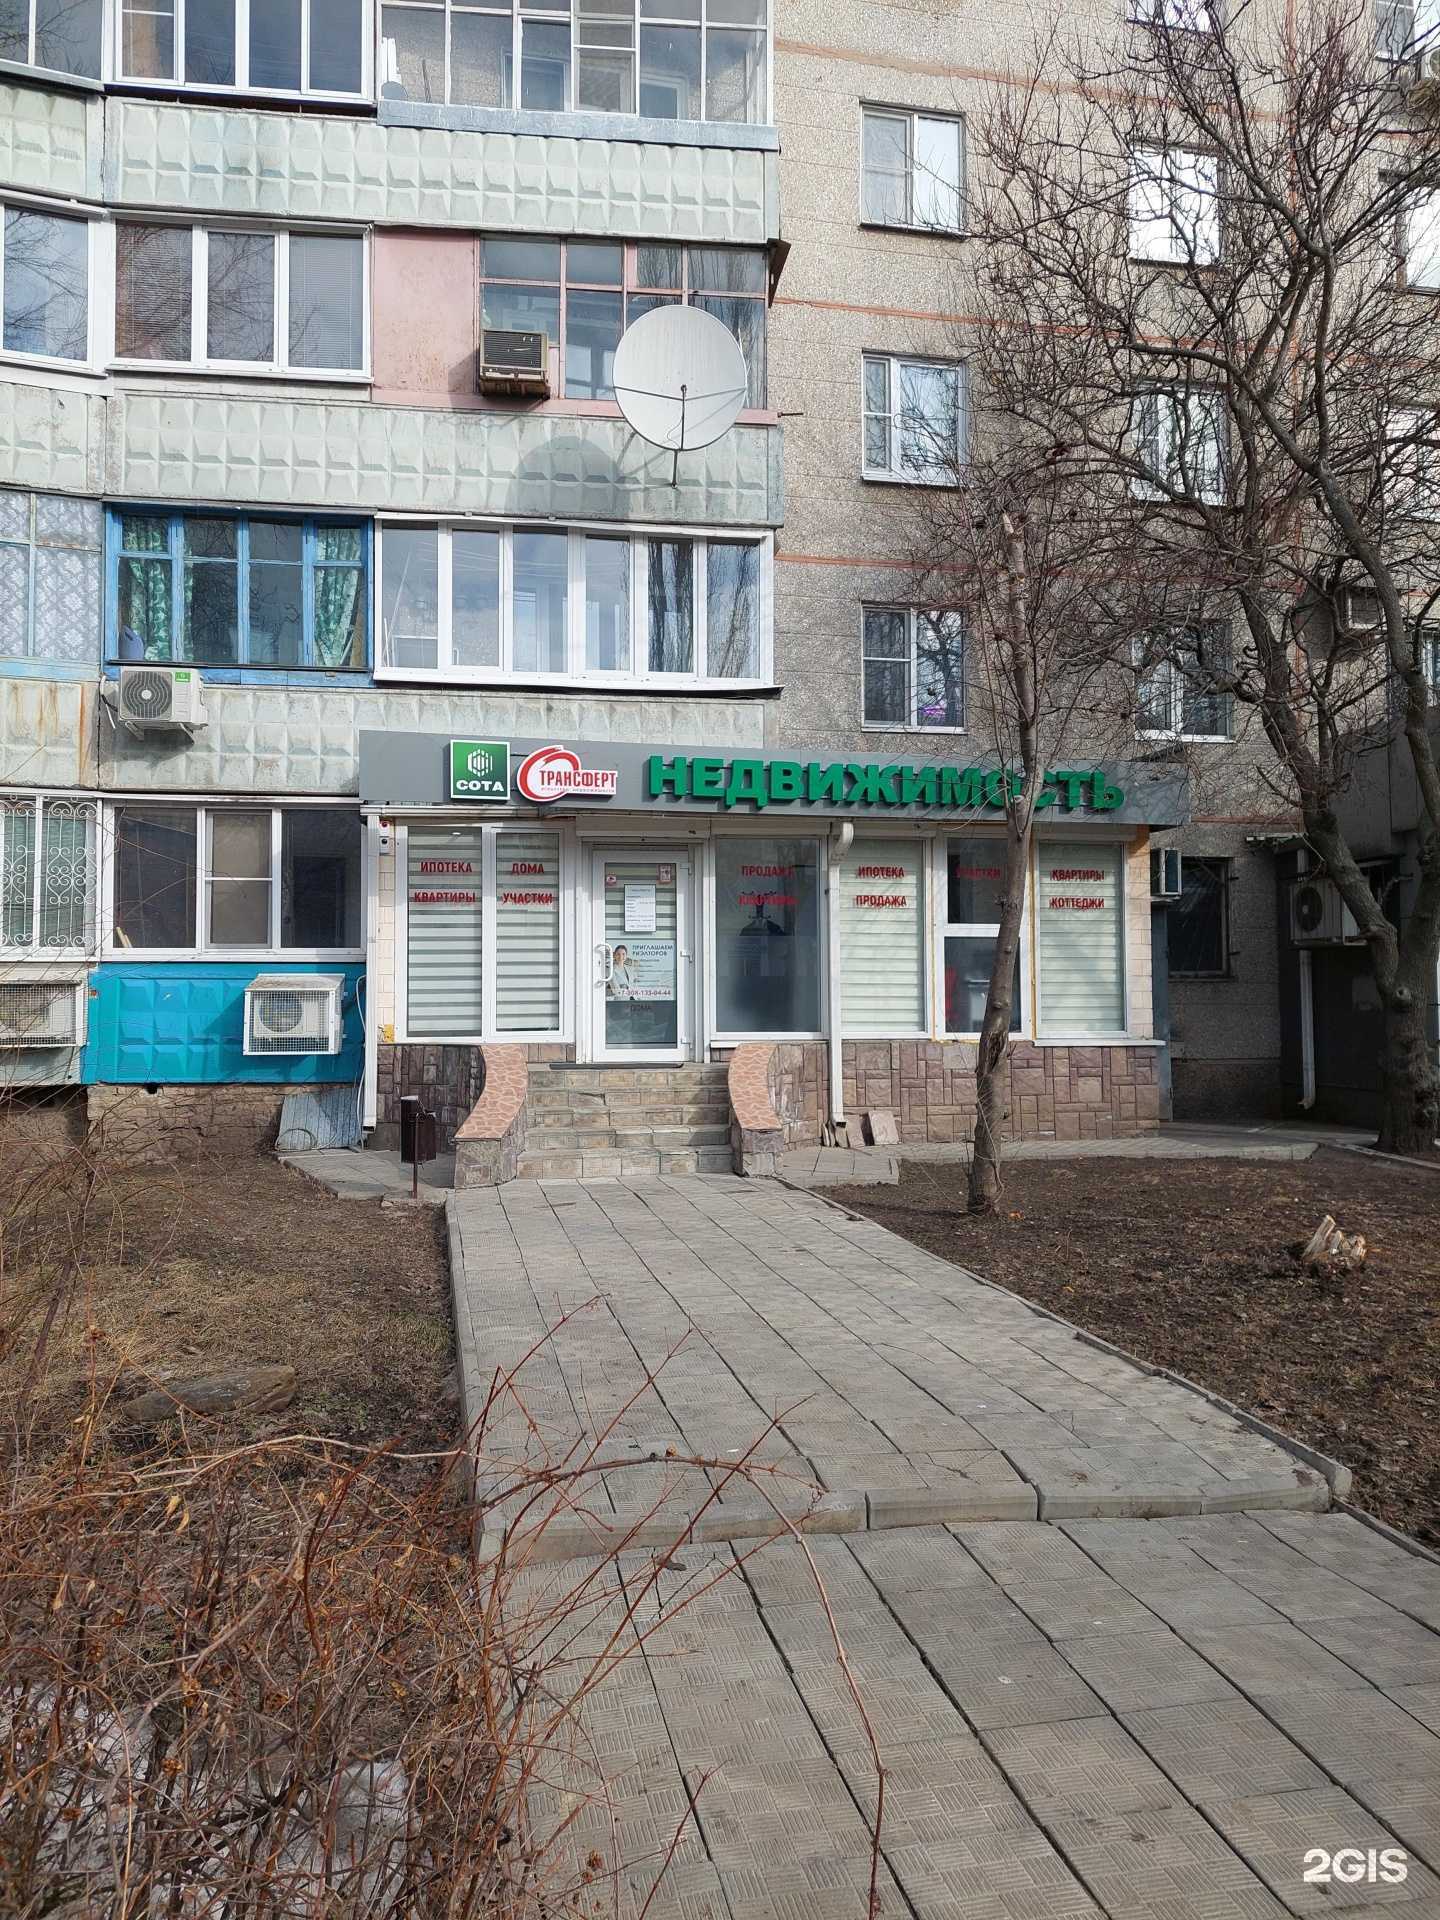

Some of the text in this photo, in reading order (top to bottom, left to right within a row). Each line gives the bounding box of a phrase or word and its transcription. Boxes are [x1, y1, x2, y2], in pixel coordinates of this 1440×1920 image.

[539, 770, 616, 788] ТРАНСФЕРТ
[456, 780, 504, 792] СОТА
[420, 861, 473, 873] ИПОТЕКА
[511, 863, 545, 875] ДОМА
[857, 866, 905, 878] ИПОТЕКА
[1050, 869, 1105, 881] КВАРТИРЫ
[413, 892, 476, 903] КВАРТИРЫ
[503, 893, 553, 904] УЧАСТКИ
[855, 895, 907, 907] ПРОДАЖА
[1050, 897, 1105, 910] КОТТЕДЖИ
